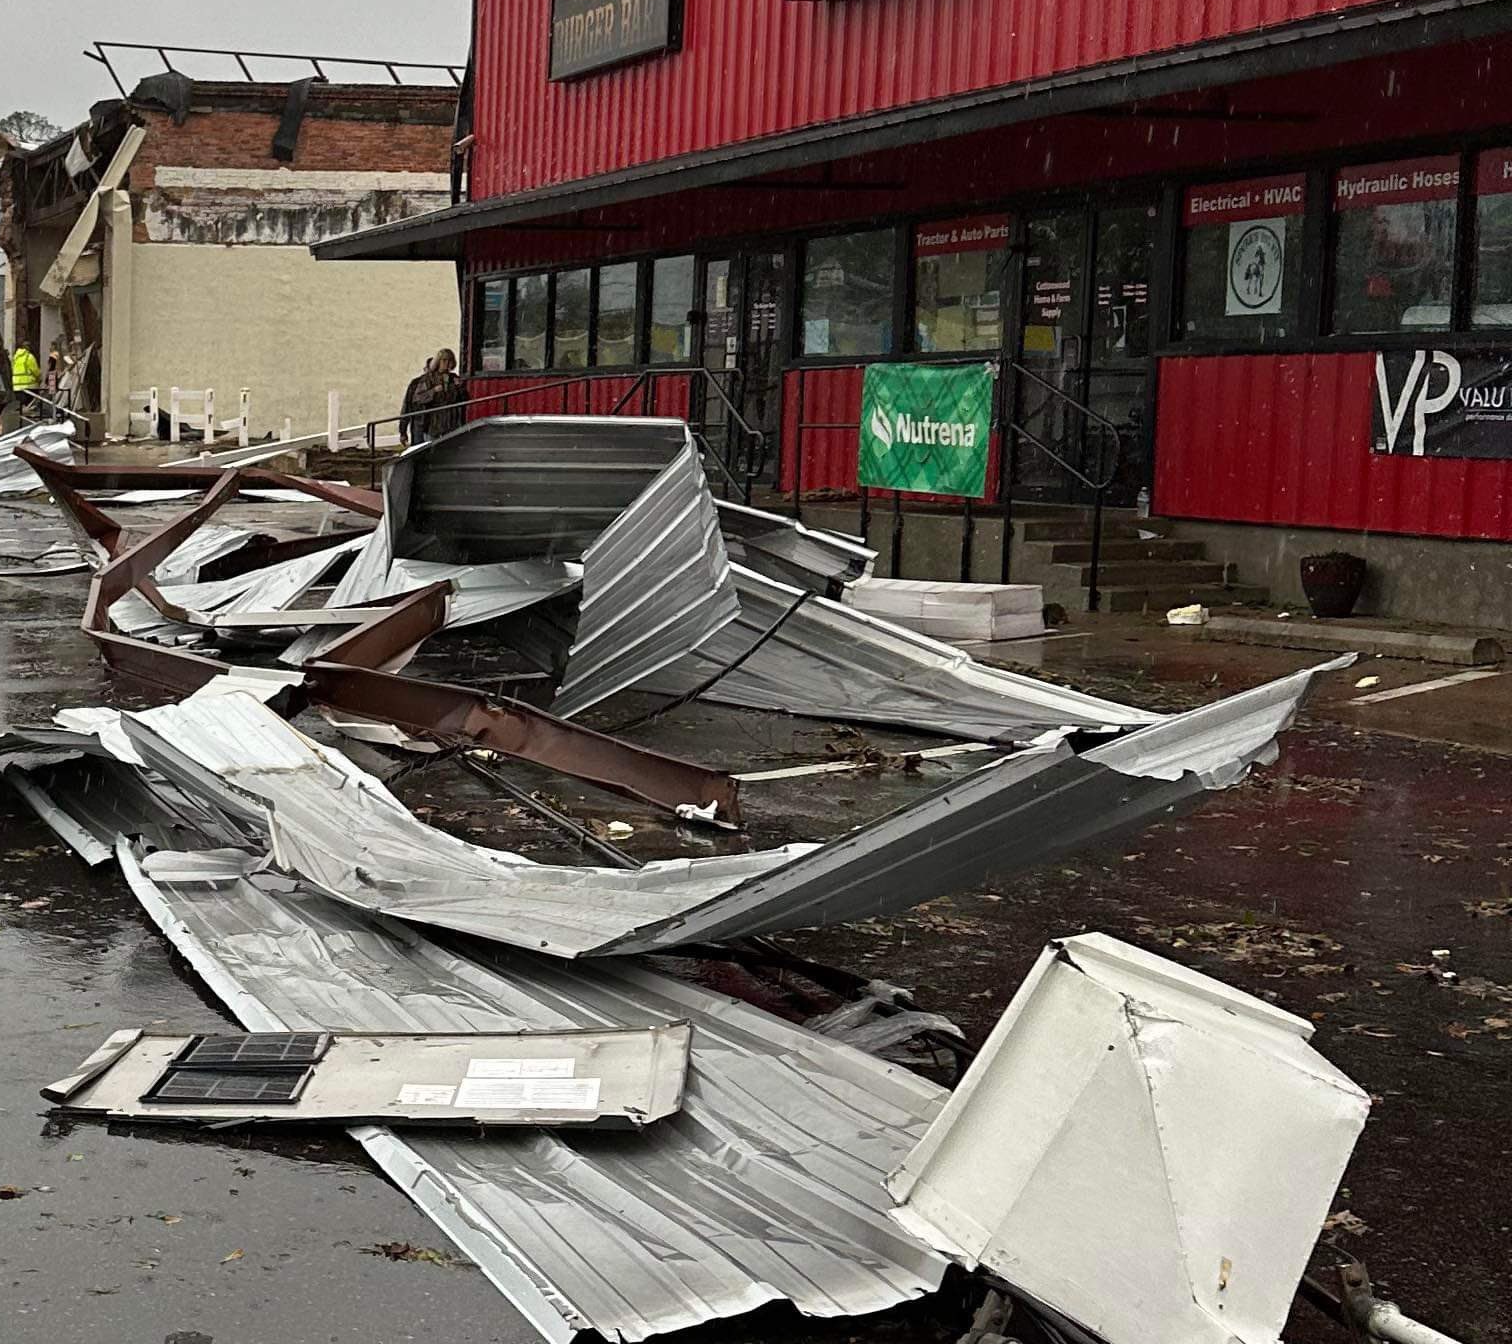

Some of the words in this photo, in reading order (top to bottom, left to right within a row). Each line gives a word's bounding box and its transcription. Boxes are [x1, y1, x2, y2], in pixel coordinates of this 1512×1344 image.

[552, 3, 615, 66] BURGER
[1190, 192, 1251, 214] Electrical
[1263, 185, 1303, 205] HVAC
[1336, 174, 1408, 201] Hydraulic
[1412, 169, 1460, 188] Hoses
[915, 231, 951, 248] Tractor
[950, 229, 959, 244] &
[960, 227, 983, 242] Auto
[983, 223, 1010, 239] Parts
[1375, 350, 1462, 456] VP
[1459, 385, 1506, 408] VALU
[896, 412, 976, 448] Nutrena
